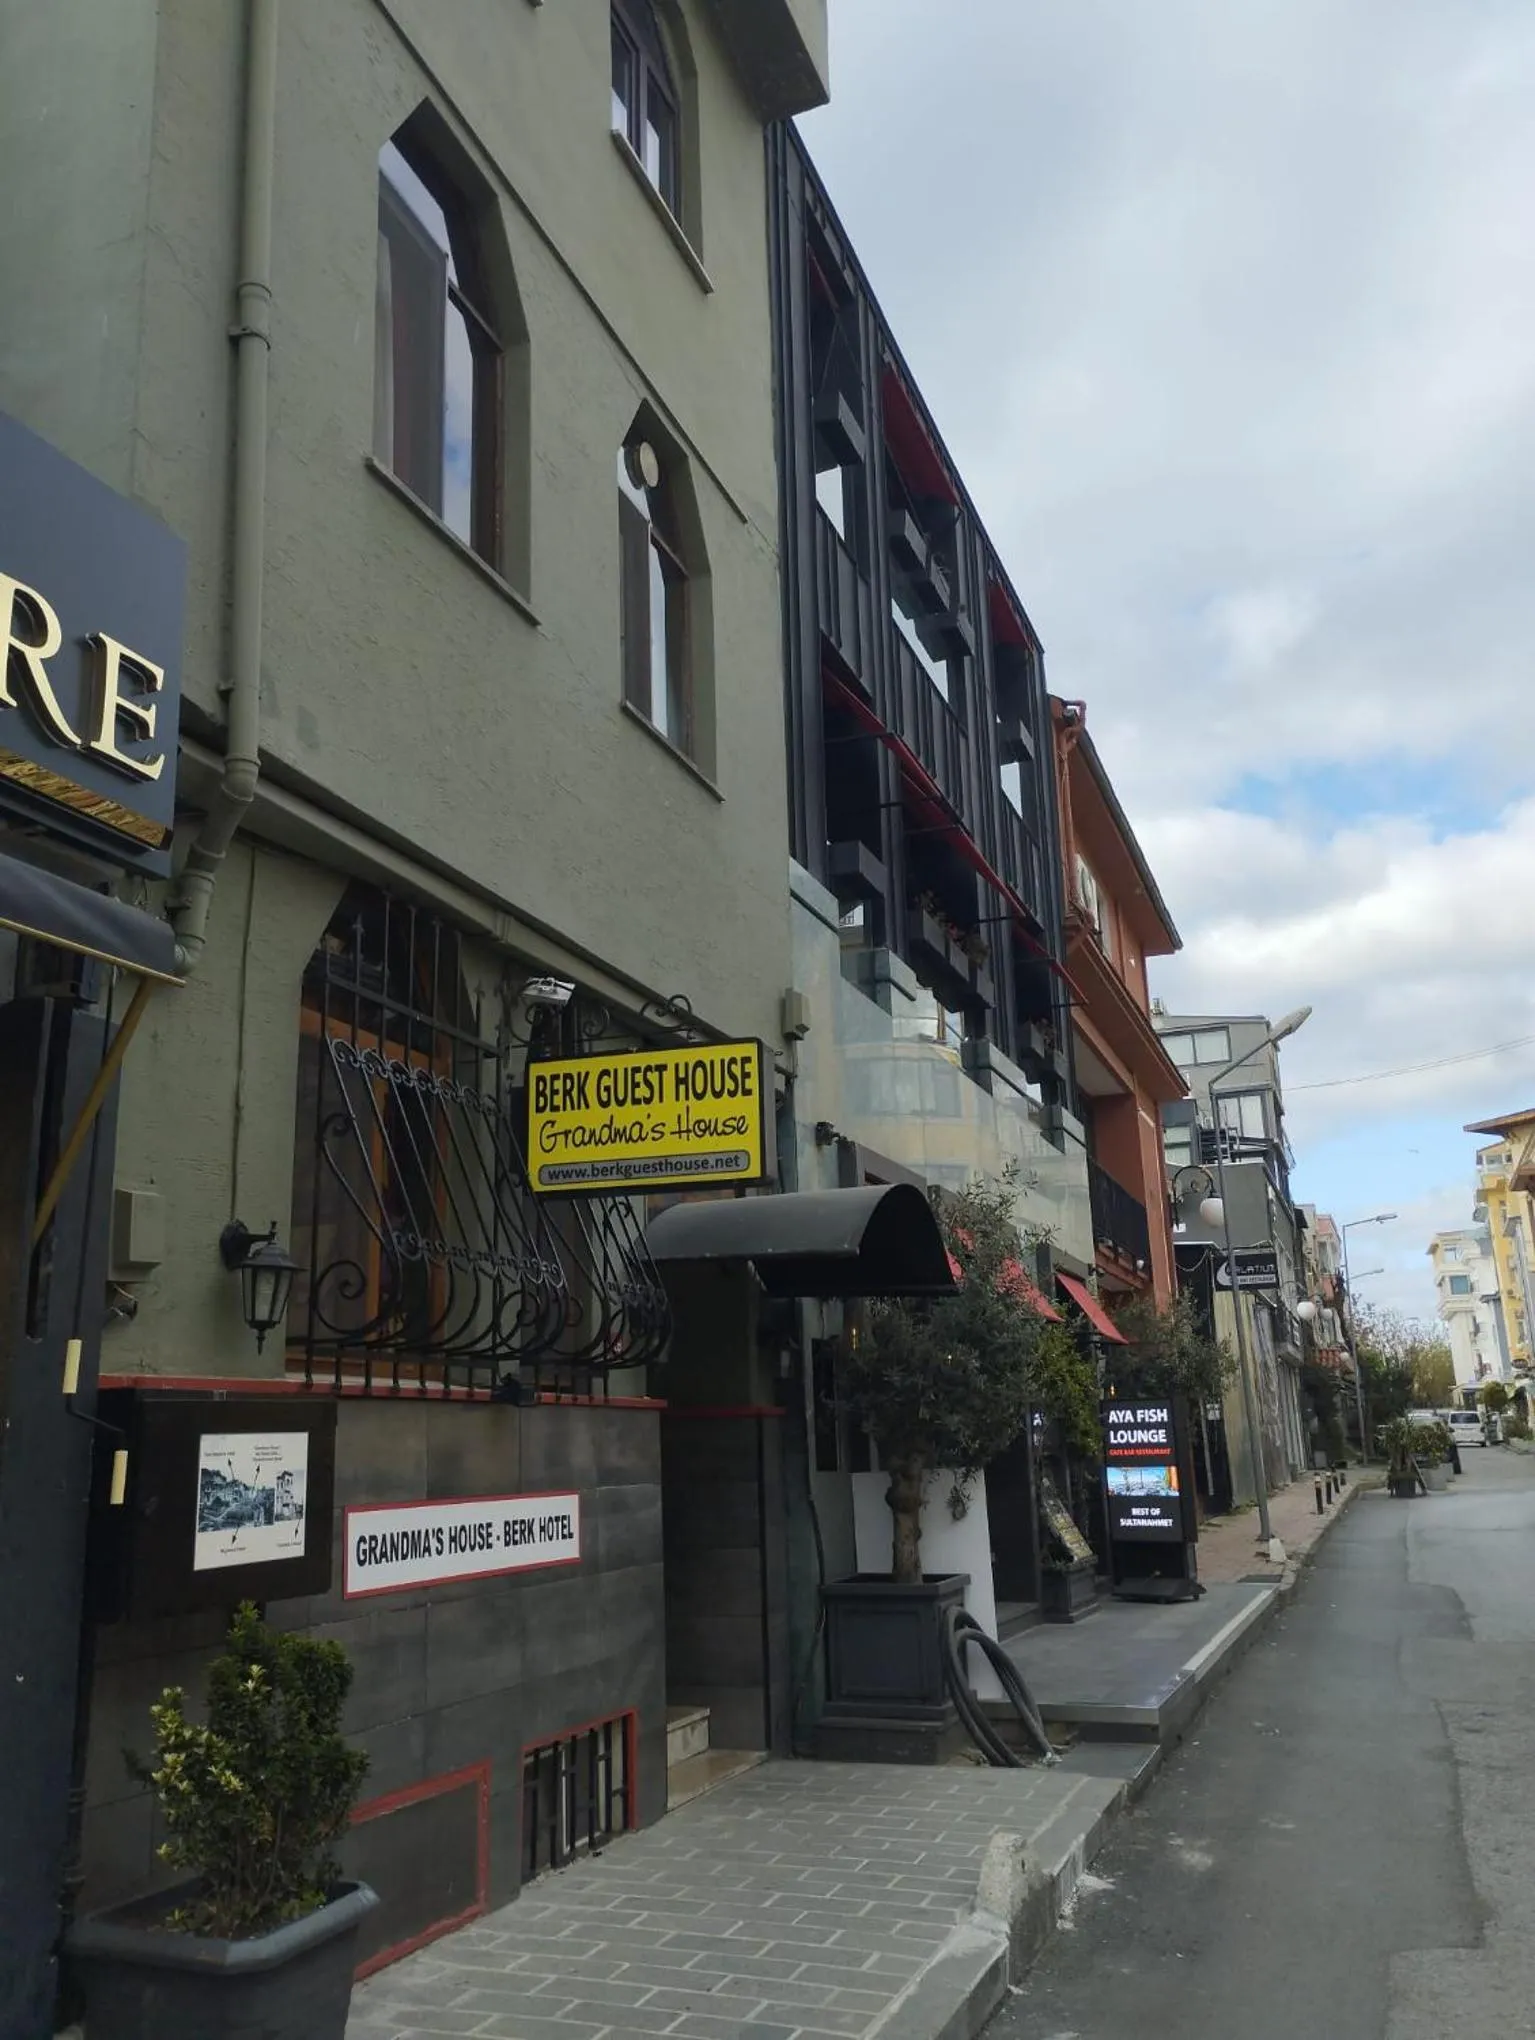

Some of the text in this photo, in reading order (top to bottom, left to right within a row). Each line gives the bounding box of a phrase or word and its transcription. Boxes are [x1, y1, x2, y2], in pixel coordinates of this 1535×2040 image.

[0, 572, 165, 781] RE
[535, 1056, 753, 1114] BERK GUEST HOUSE
[539, 1104, 749, 1153] Grandma's House
[548, 1154, 740, 1181] www.berkguesthouse.net
[1108, 1408, 1168, 1424] AYA FISH
[1109, 1429, 1167, 1444] LOUNGE
[1150, 1507, 1160, 1516] OF
[356, 1527, 444, 1566] GRANDMA'S
[449, 1522, 493, 1554] HOUSE
[503, 1517, 535, 1547] BERK
[539, 1514, 574, 1543] HOTEL
